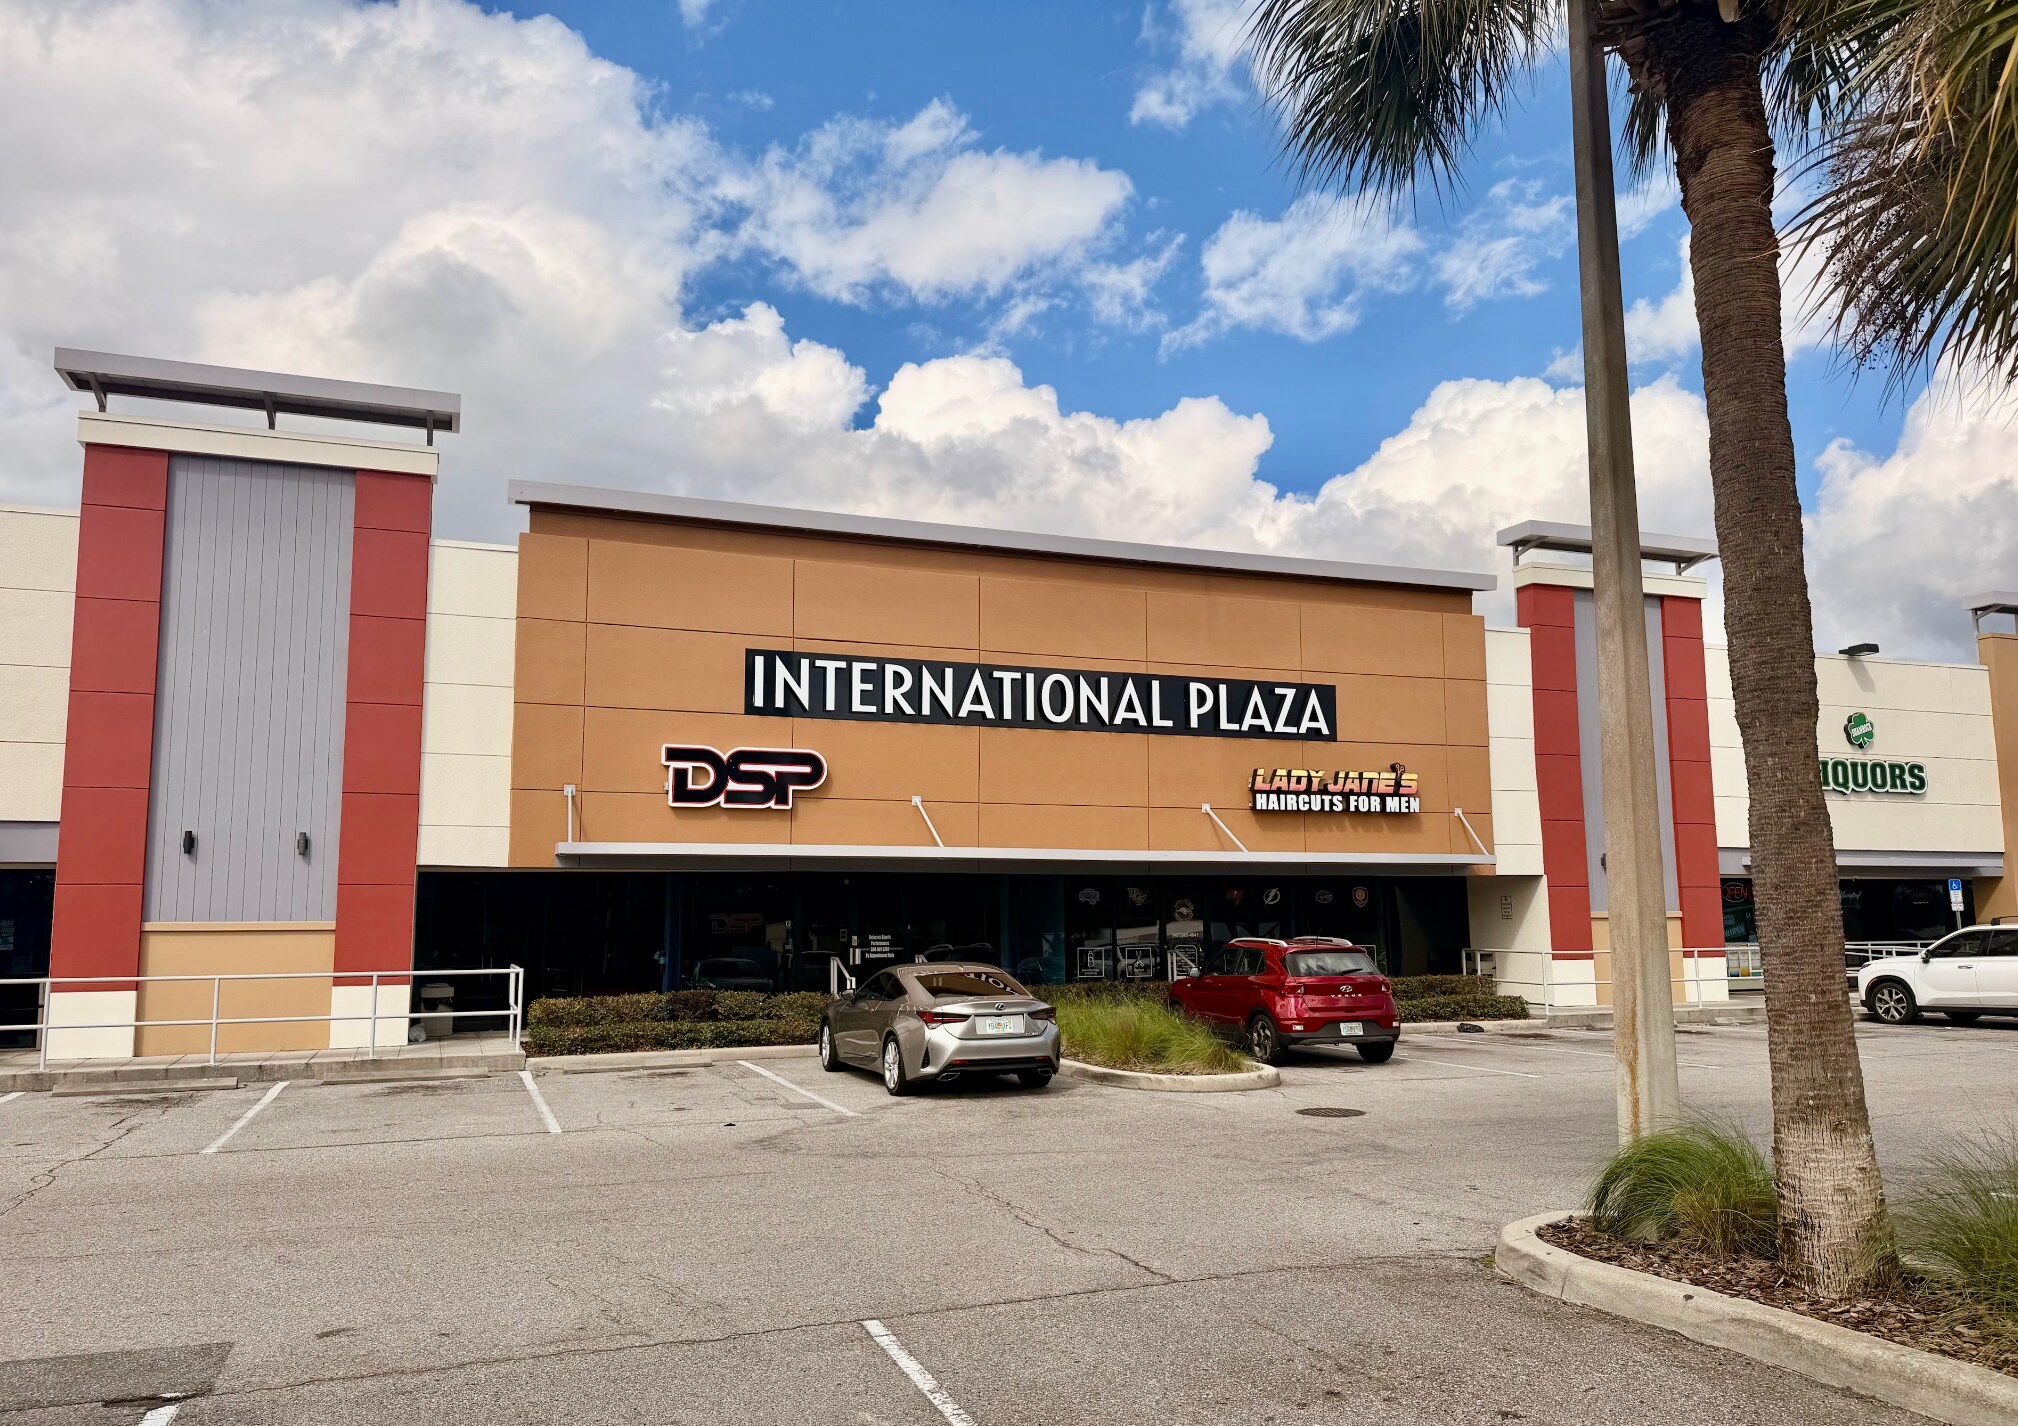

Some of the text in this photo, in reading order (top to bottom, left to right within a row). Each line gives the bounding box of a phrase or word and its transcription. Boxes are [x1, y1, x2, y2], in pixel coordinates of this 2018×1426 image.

[753, 654, 1330, 735] INTERNATIONAL PLAZA
[661, 743, 828, 809] DSP
[1253, 767, 1326, 792] LADY
[1819, 757, 1928, 794] IQUORS
[1255, 793, 1420, 812] HAIRCUTS FOR MEN
[707, 913, 764, 934] DSP
